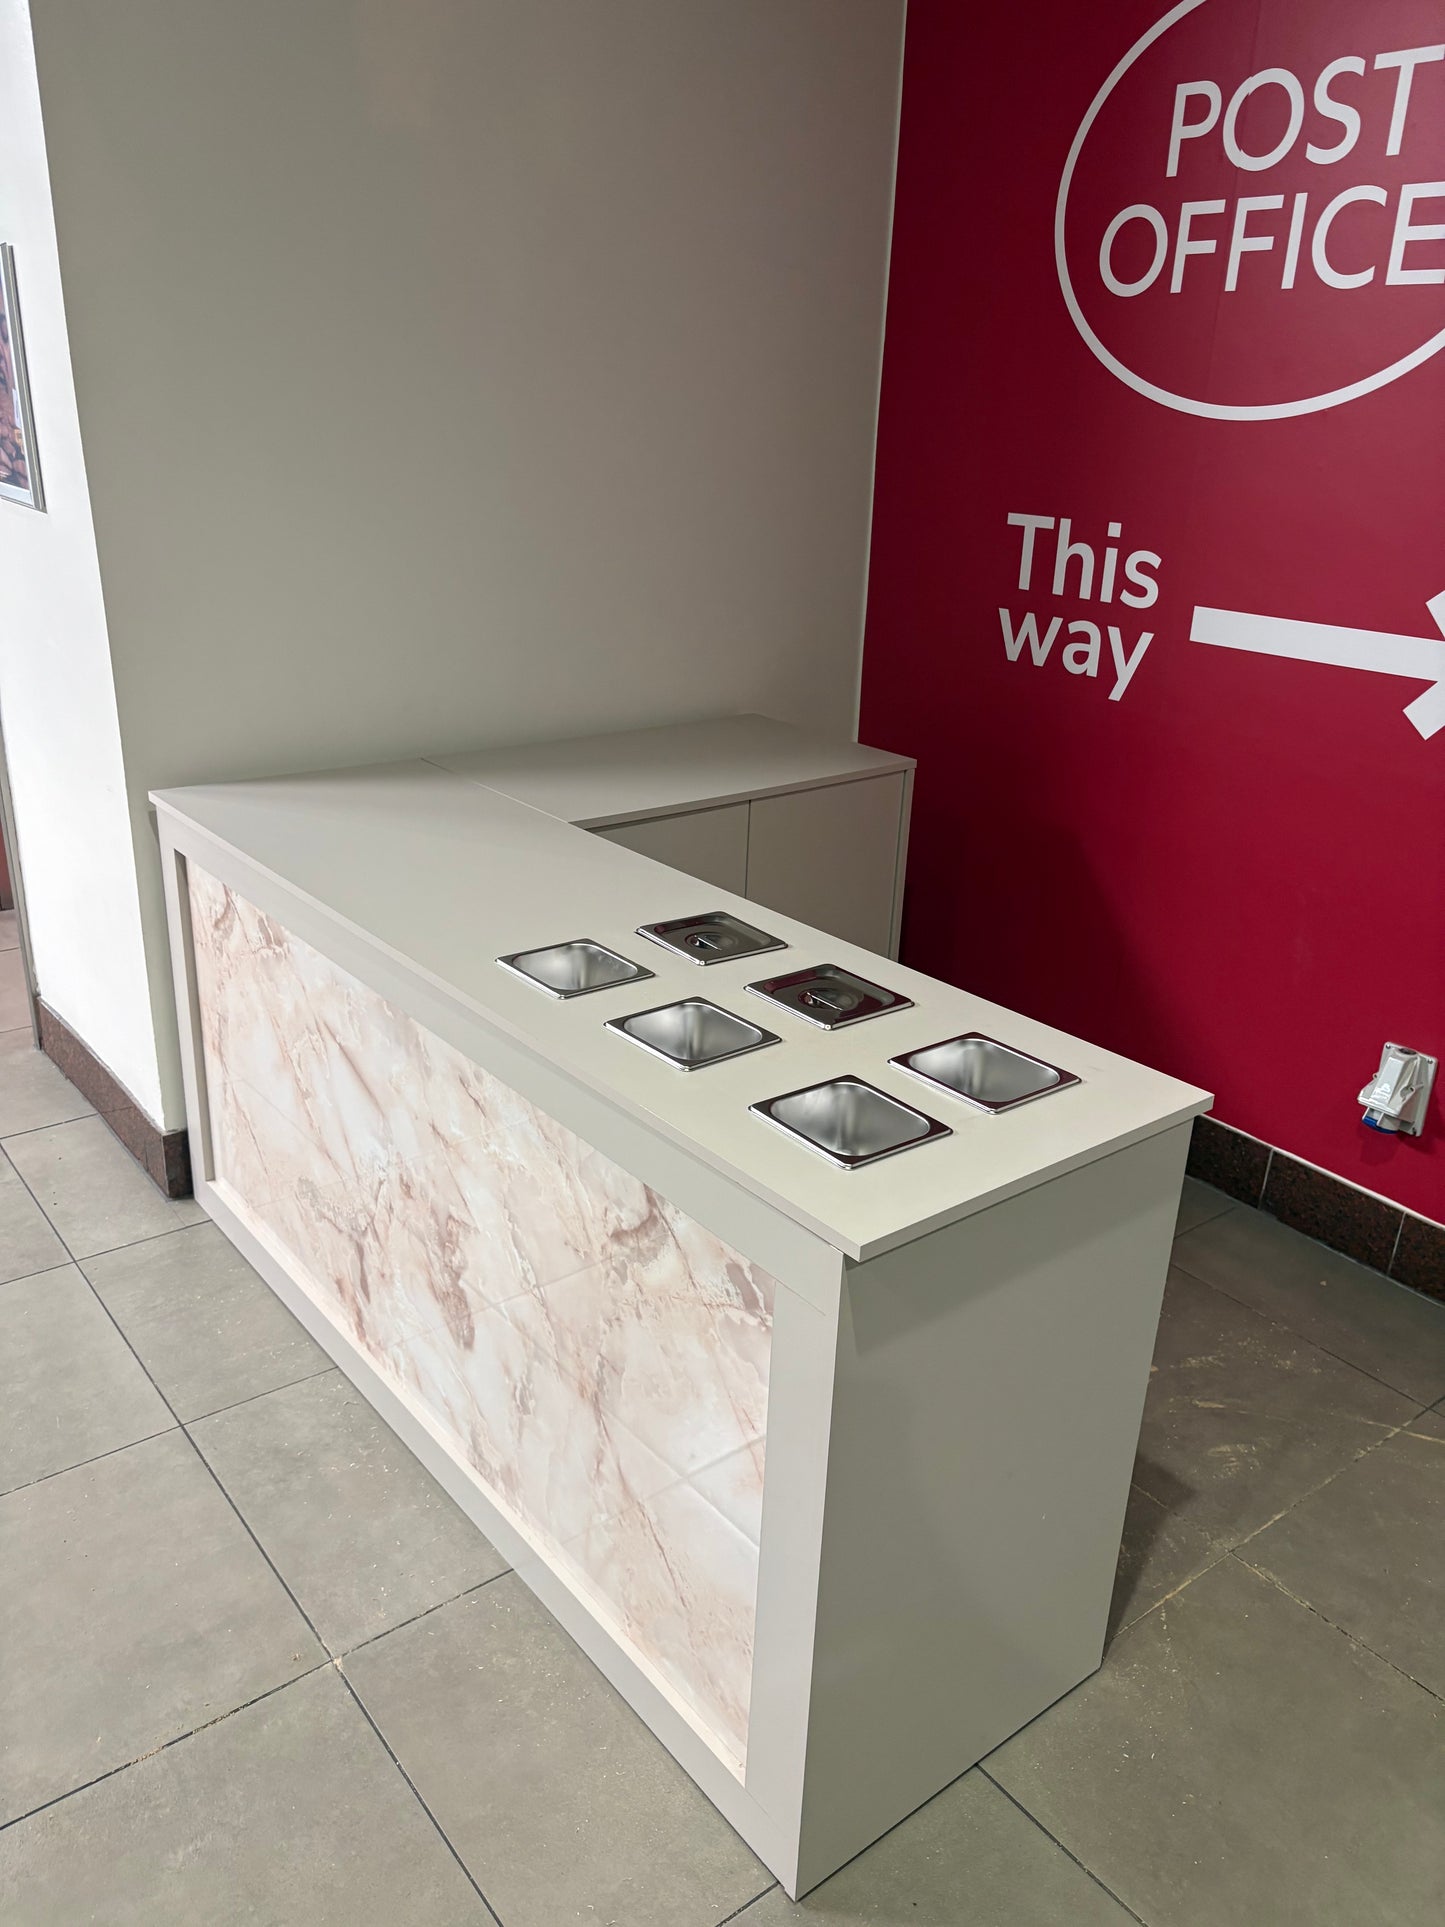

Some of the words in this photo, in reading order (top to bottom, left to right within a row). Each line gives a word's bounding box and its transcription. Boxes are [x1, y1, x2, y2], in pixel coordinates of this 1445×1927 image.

[1165, 44, 1445, 178] POST
[1099, 181, 1445, 297] OFFICE
[1007, 513, 1162, 609] This
[998, 607, 1155, 702] way
